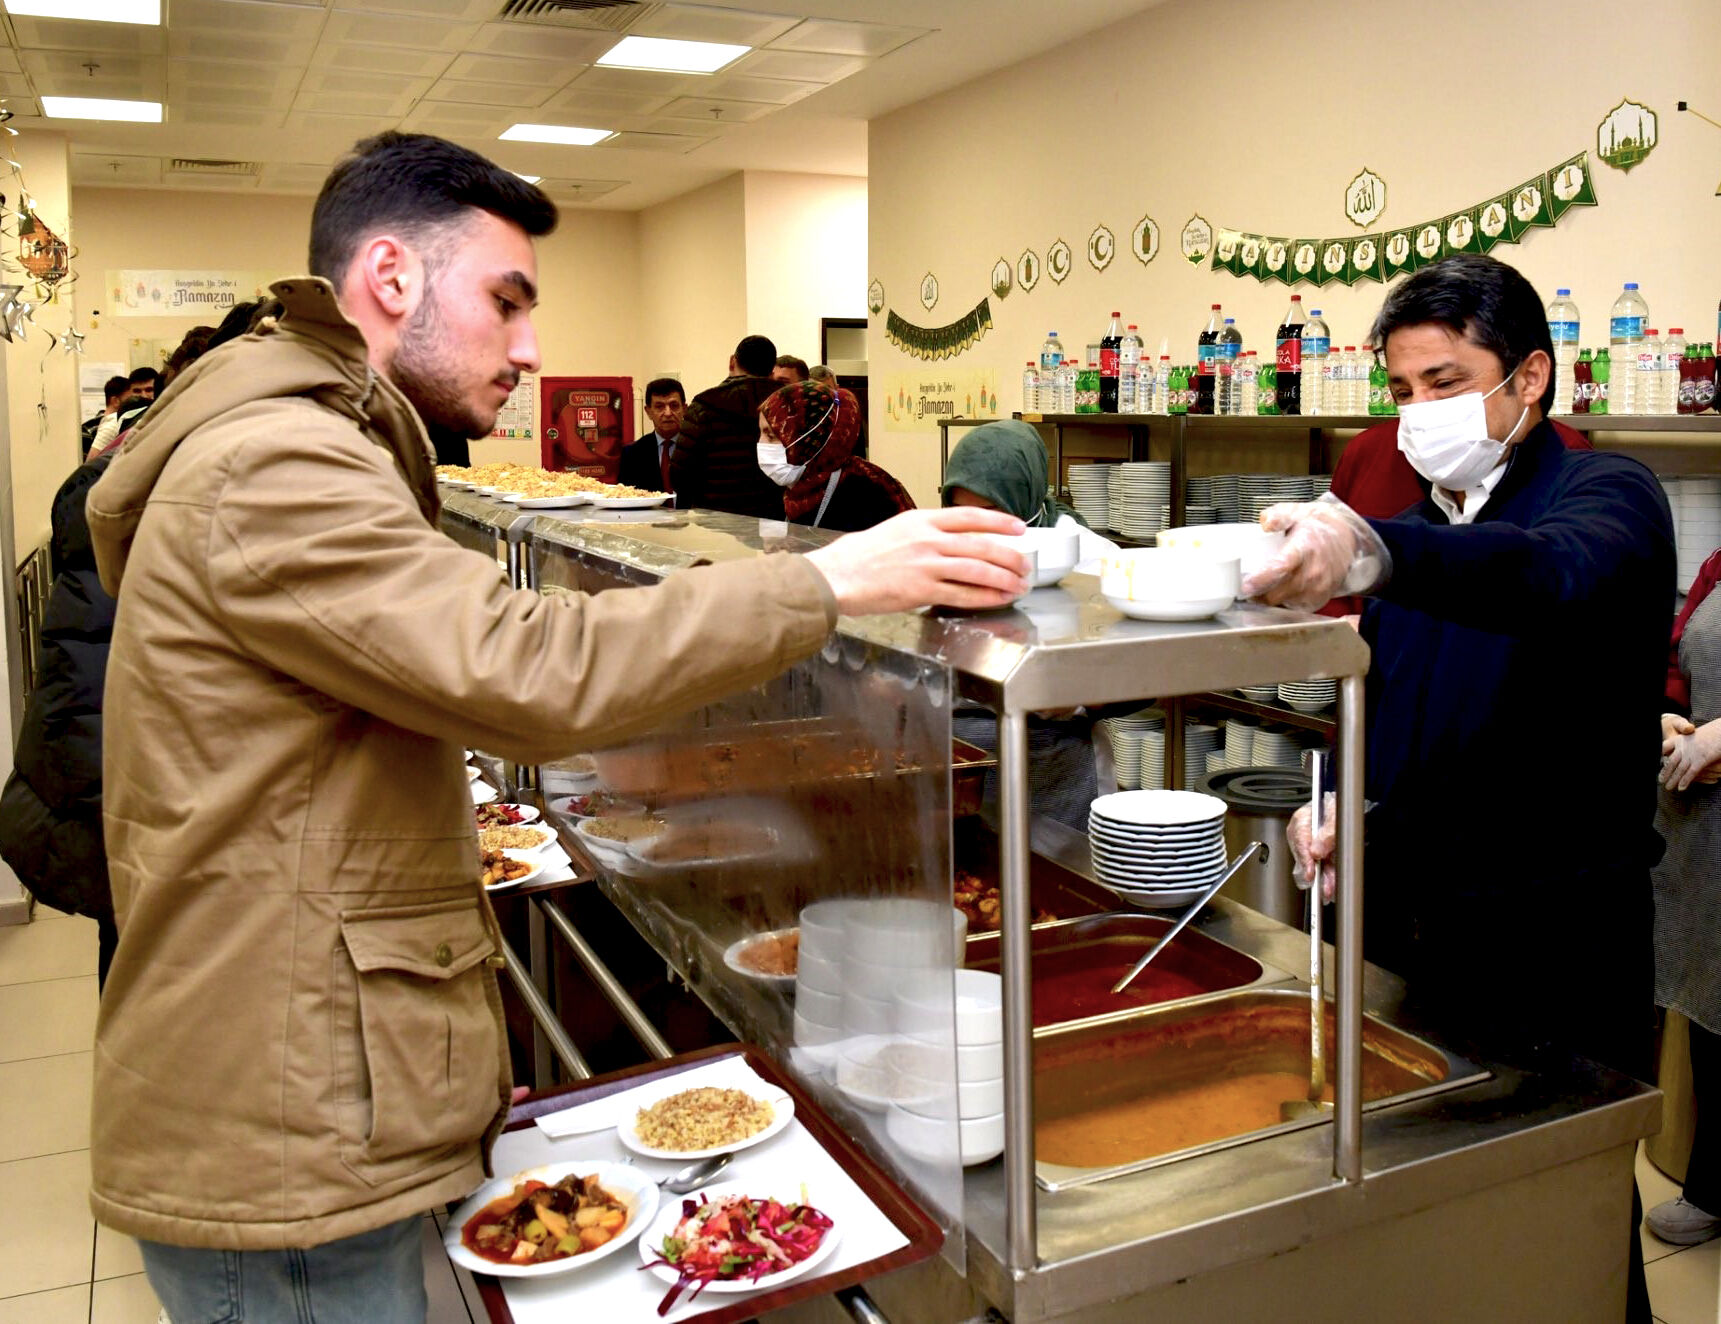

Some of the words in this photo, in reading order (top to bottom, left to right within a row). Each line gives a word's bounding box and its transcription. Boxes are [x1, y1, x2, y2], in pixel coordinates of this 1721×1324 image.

[172, 288, 236, 310] Ramazan
[580, 410, 595, 420] 112
[917, 395, 965, 420] Ramazan
